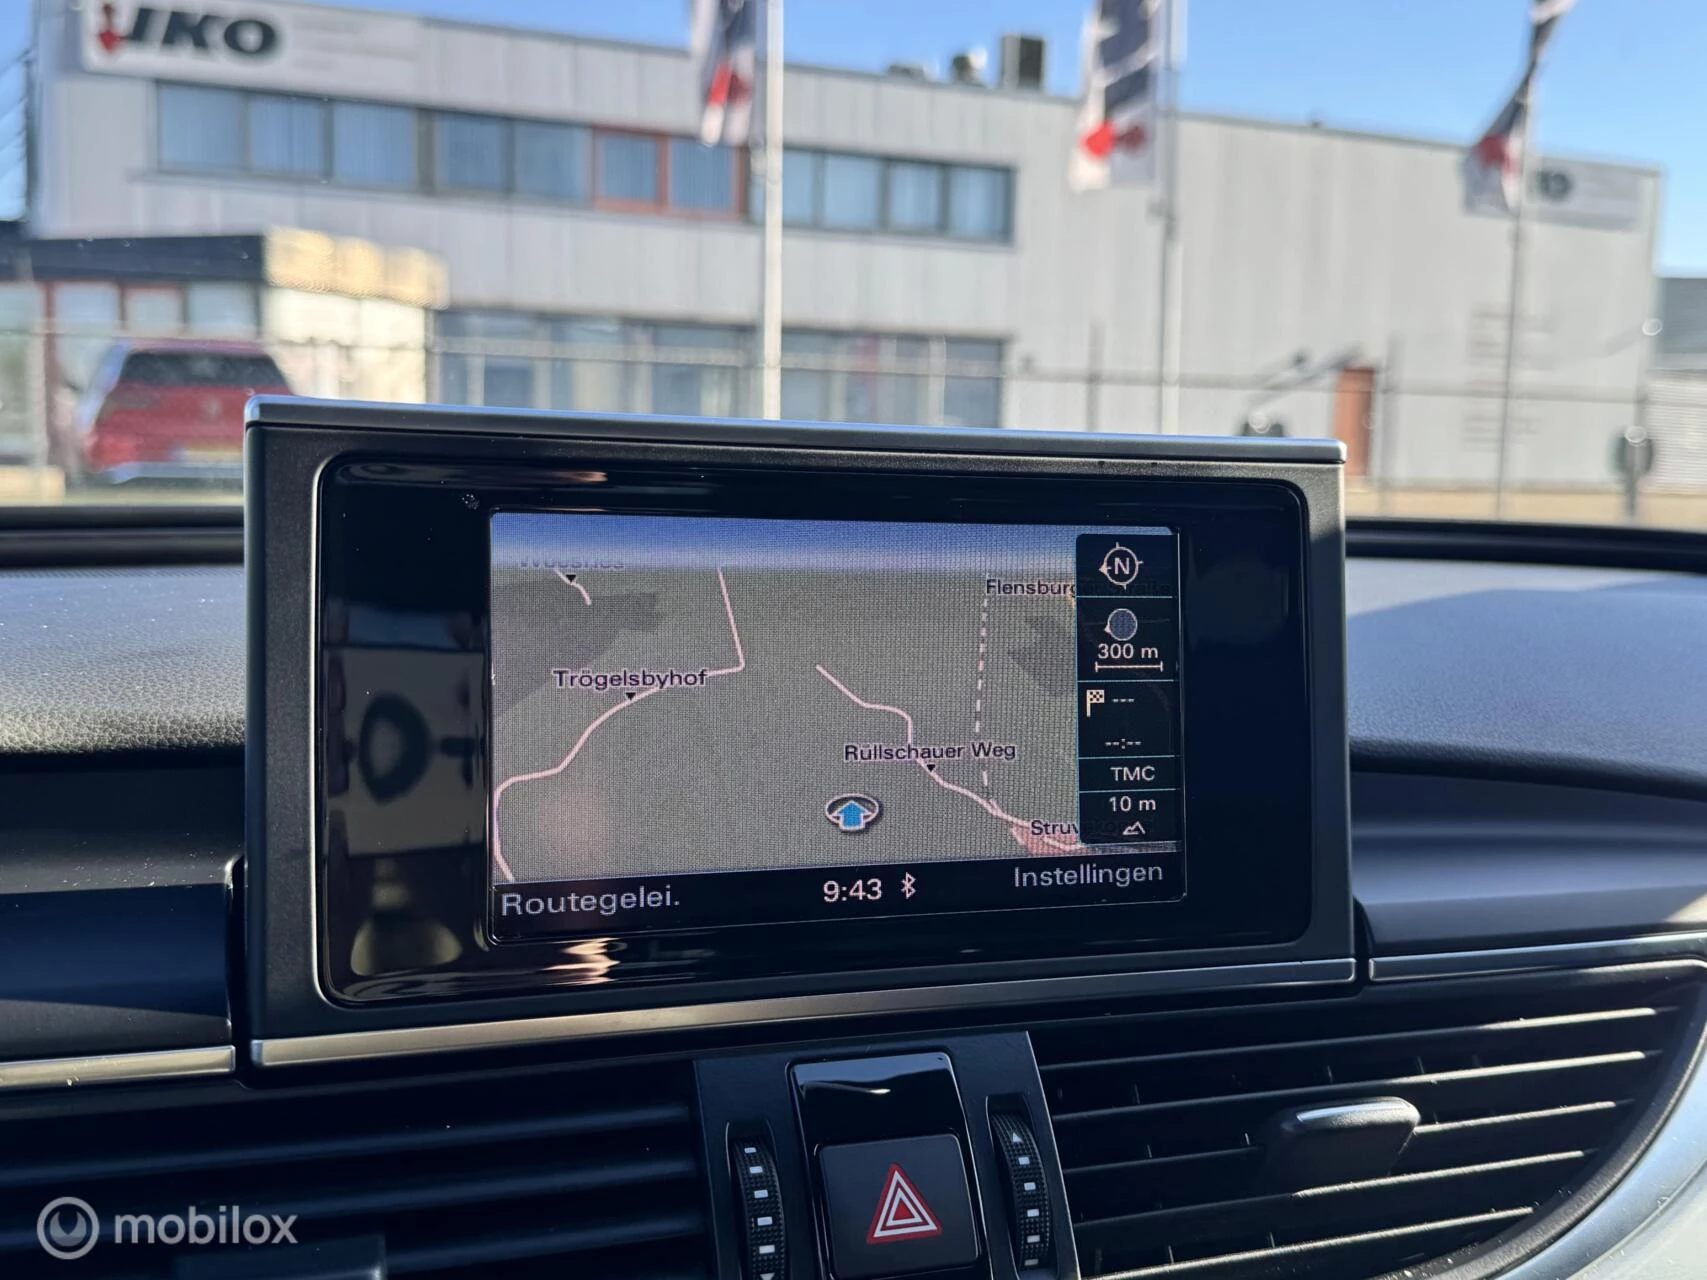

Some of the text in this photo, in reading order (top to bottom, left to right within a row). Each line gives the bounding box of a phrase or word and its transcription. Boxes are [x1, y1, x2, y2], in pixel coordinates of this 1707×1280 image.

[1114, 557, 1130, 575] N
[1097, 643, 1159, 659] 300 m
[553, 669, 708, 691] Trögelsbyhof
[844, 742, 1016, 761] Rüllschauer Weg
[1110, 765, 1155, 782] TMC
[1109, 796, 1156, 812] 10 m
[1014, 864, 1163, 887] Instellingen
[823, 878, 882, 903] 9:43
[502, 885, 680, 916] Routegelei.
